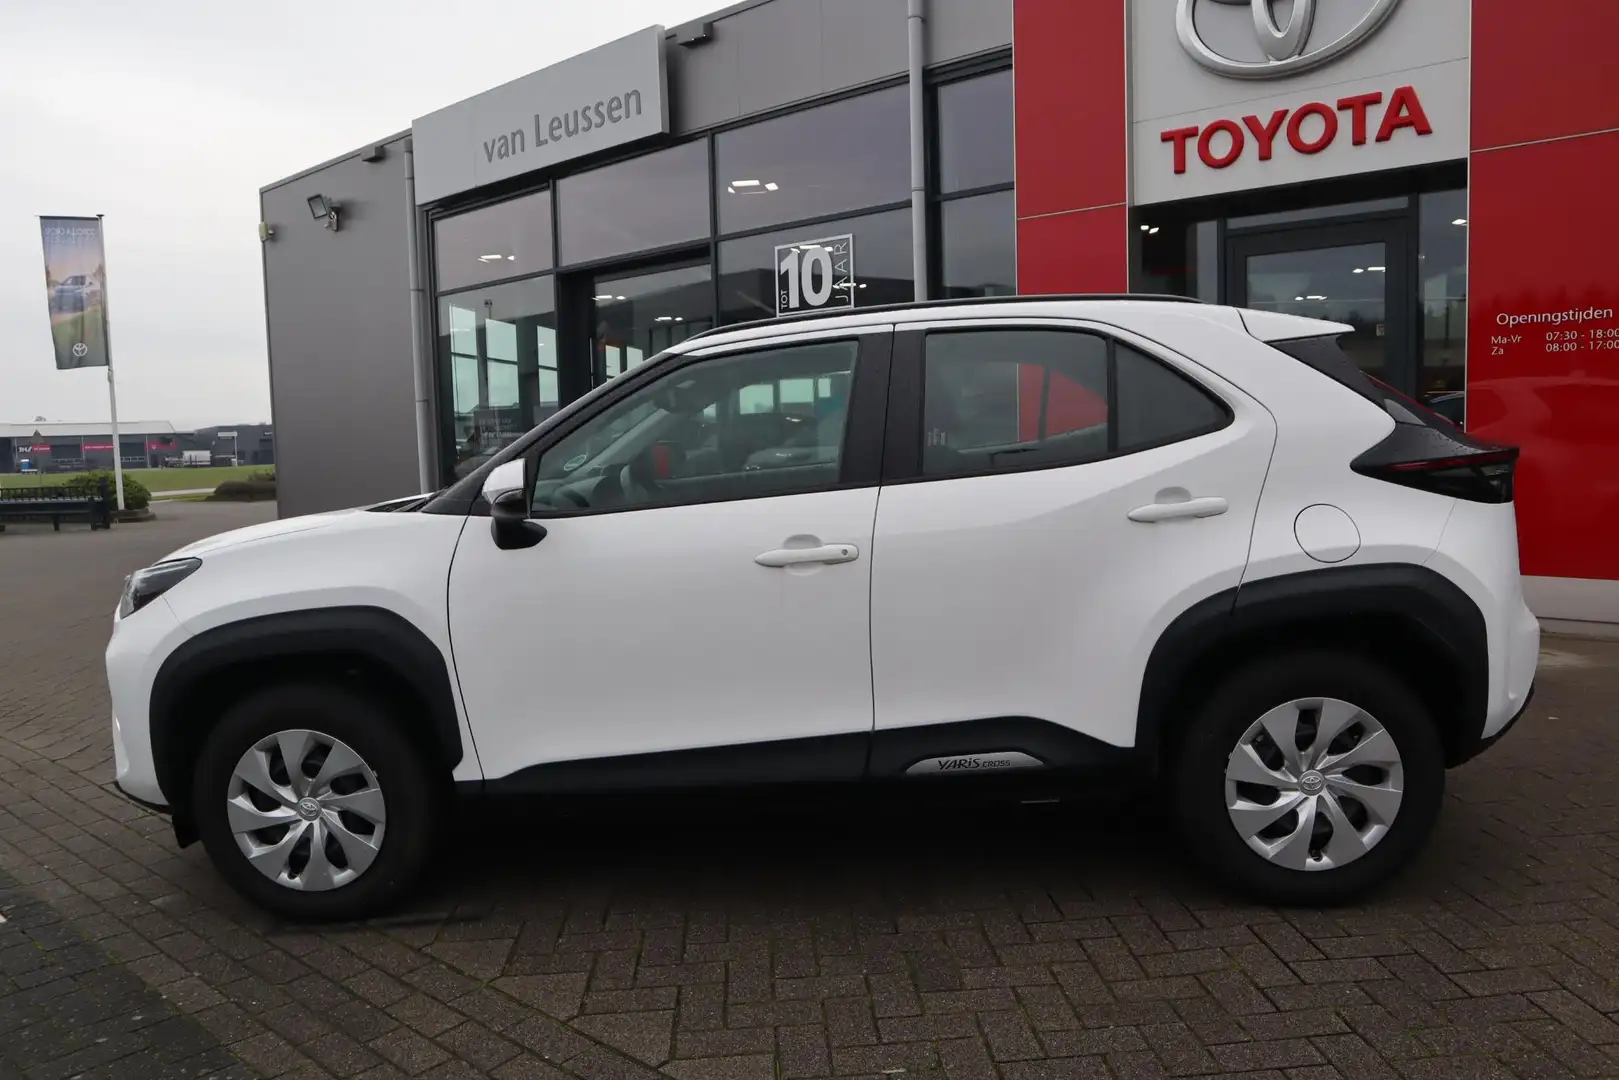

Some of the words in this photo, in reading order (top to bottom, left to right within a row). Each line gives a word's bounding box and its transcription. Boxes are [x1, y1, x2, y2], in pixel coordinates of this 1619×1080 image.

[483, 128, 525, 163] van
[534, 89, 642, 147] Leussen
[1160, 85, 1433, 174] TOYOTA
[780, 245, 833, 309] 10
[834, 241, 849, 303] JAAR
[780, 289, 788, 309] TOT
[1496, 306, 1613, 328] Openingstijden
[1491, 334, 1522, 344] Ma-Vr
[1546, 331, 1577, 341] 07:30
[1589, 328, 1619, 339] 18:00
[1491, 346, 1504, 355] Za
[1546, 342, 1577, 352] 08:00
[1589, 340, 1619, 350] 17:00
[982, 760, 1011, 768] CROSS
